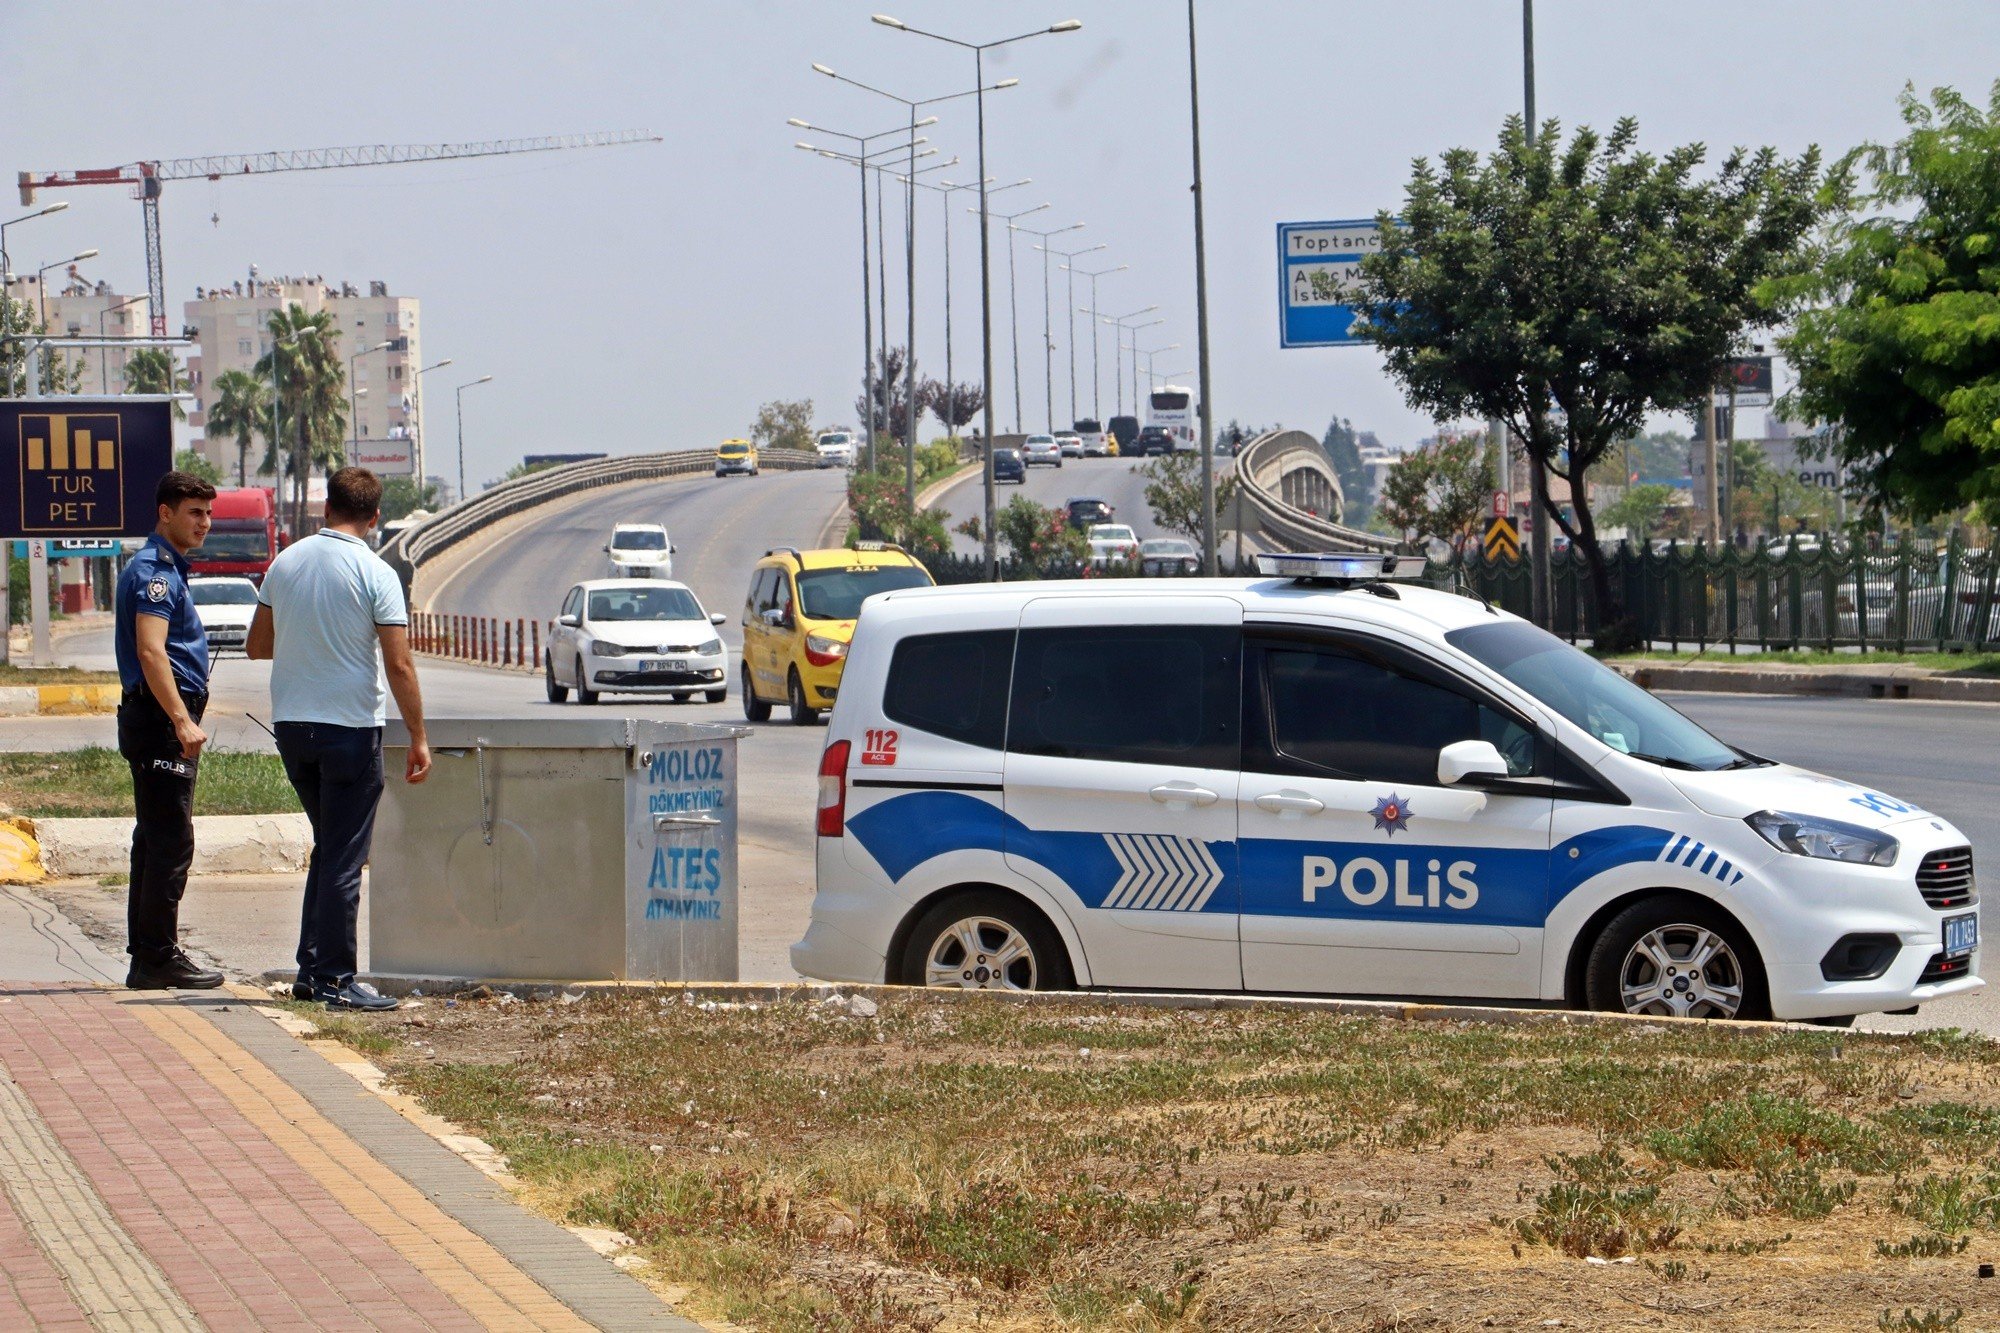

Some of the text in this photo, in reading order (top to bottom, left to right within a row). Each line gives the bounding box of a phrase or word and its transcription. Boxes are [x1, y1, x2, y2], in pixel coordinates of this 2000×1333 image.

[47, 476, 95, 494] TUR
[50, 503, 96, 521] PET
[865, 729, 898, 753] 112
[649, 748, 723, 784] MOLOZ
[648, 846, 721, 896] ATEŞ
